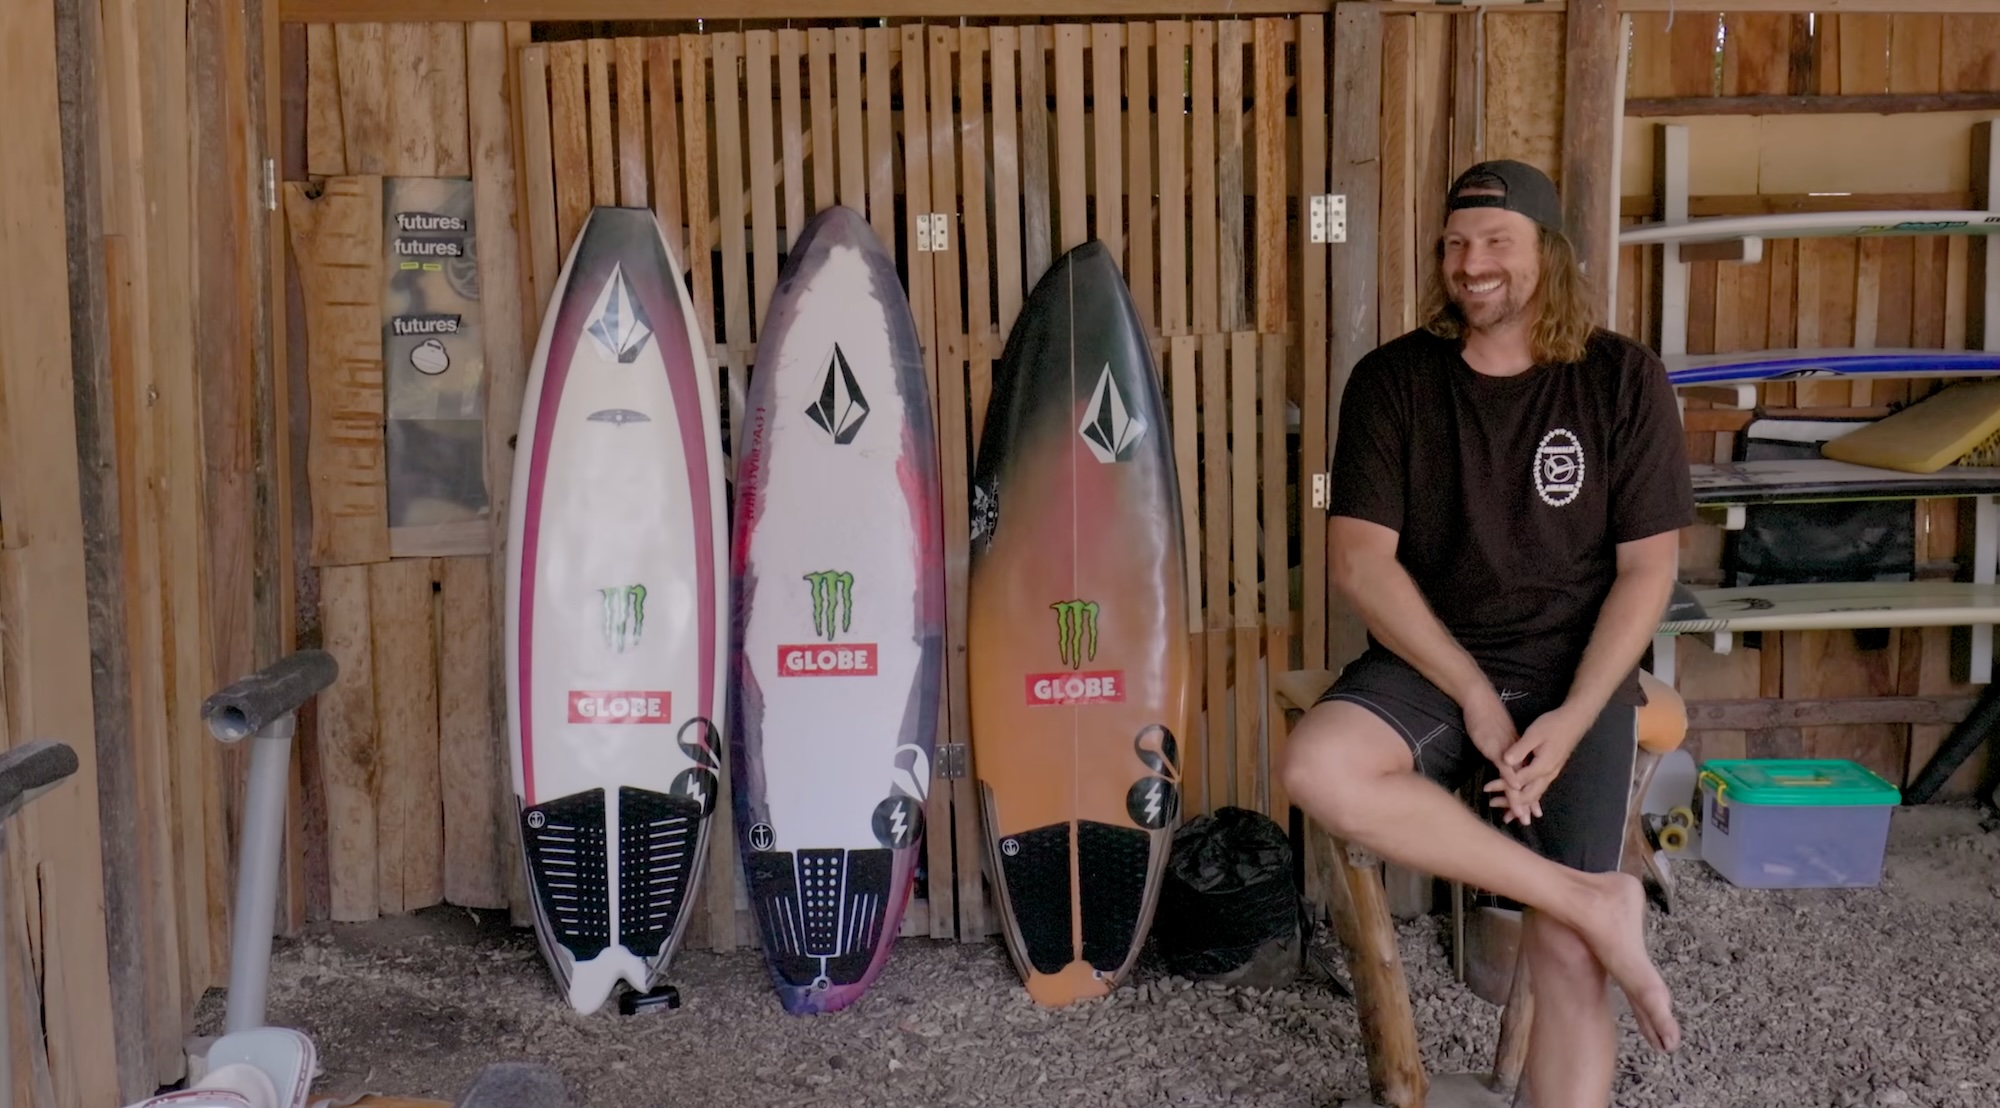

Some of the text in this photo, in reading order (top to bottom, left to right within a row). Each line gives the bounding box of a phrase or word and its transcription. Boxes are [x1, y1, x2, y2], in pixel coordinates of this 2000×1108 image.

[398, 214, 465, 230] futures.
[394, 239, 461, 256] futures.
[787, 650, 868, 671] GLOBE
[1034, 676, 1116, 700] GLOBE
[577, 697, 662, 718] GLOBE
